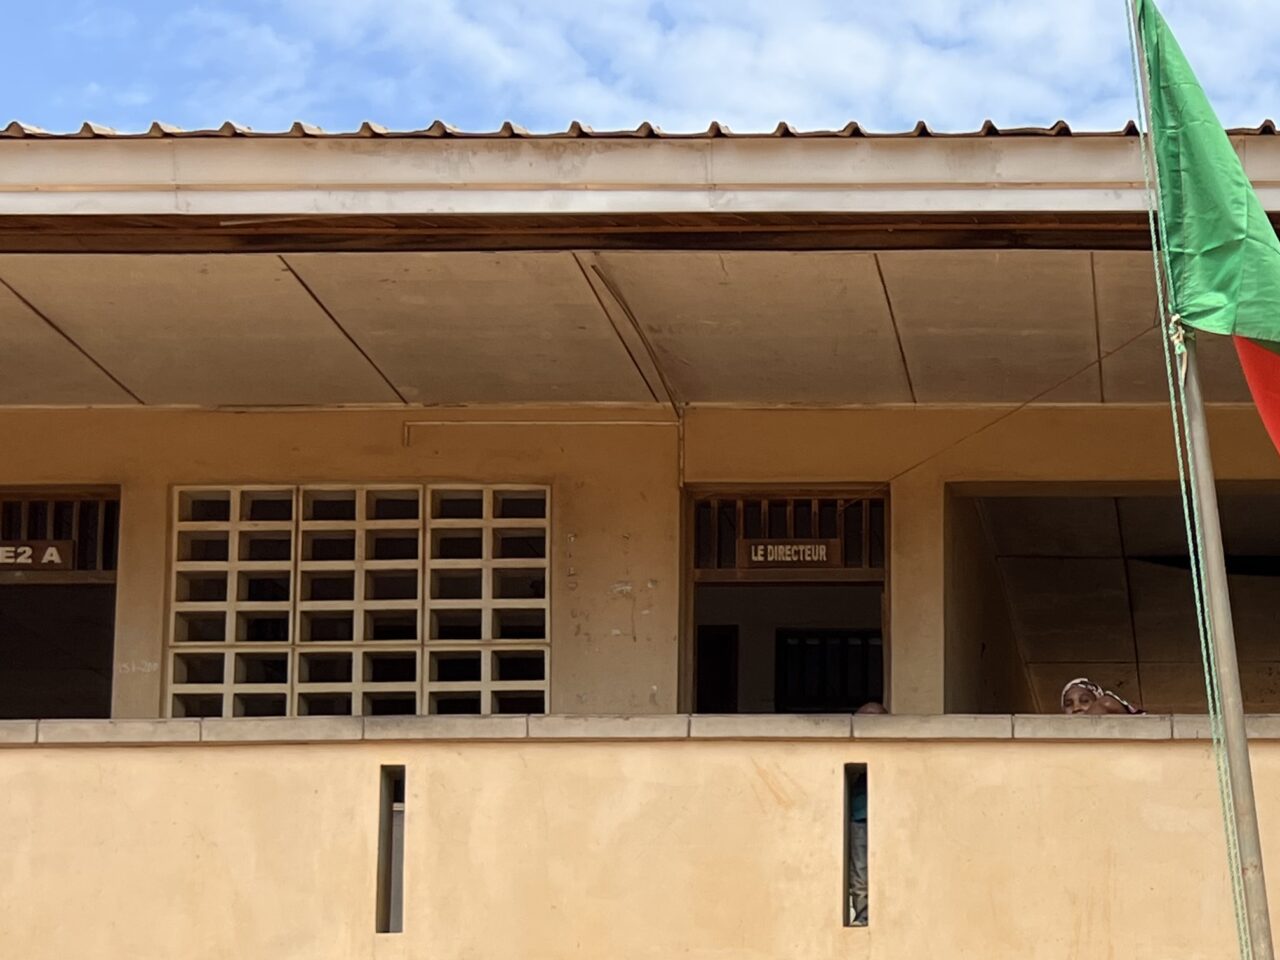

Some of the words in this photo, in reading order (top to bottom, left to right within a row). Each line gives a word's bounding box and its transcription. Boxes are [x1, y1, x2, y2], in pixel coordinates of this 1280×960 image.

[41, 546, 62, 564] A
[751, 545, 764, 561] LE
[767, 544, 827, 561] DIRECTEUR
